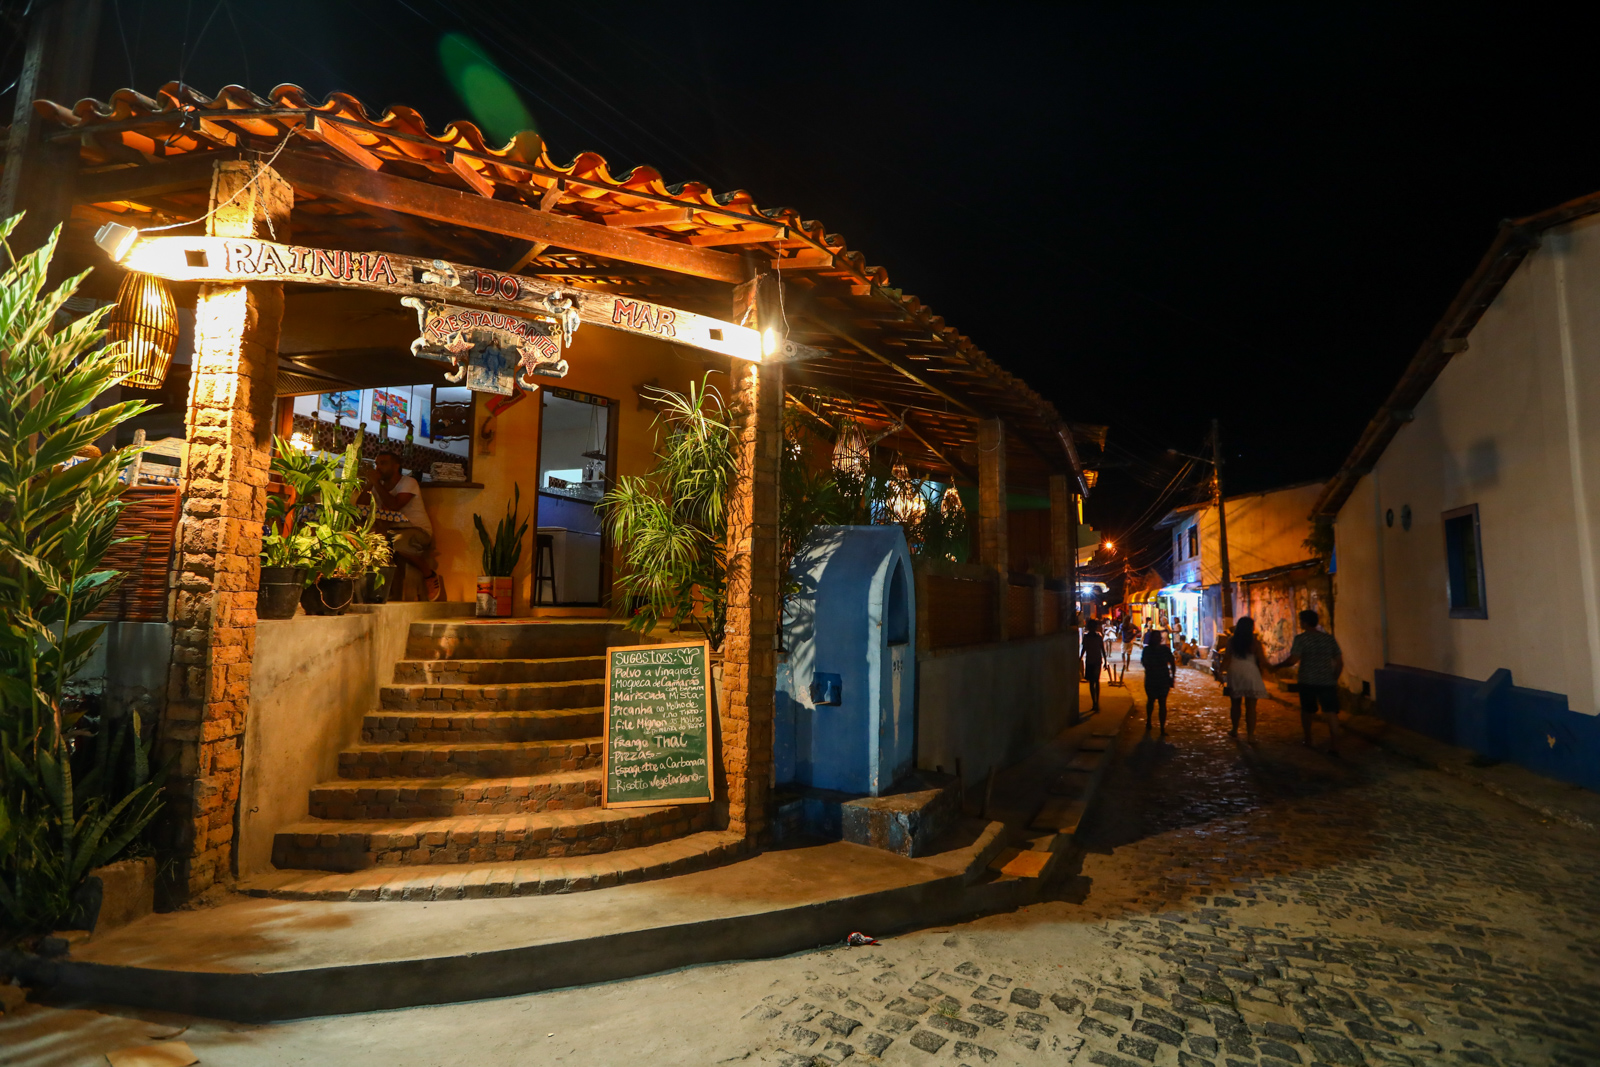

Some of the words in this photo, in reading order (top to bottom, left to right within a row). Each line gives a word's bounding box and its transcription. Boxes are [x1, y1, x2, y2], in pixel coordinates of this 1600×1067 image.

[224, 242, 398, 284] RAINHA
[474, 270, 520, 300] DO
[611, 299, 676, 336] MAR
[425, 311, 560, 358] RESTAURANTE
[614, 667, 642, 678] Polvo
[616, 680, 651, 693] Moqueca
[652, 679, 660, 688] de
[614, 690, 666, 702] Mariscada
[613, 702, 653, 716] Picanha
[614, 734, 649, 751] Frango
[654, 732, 687, 748] Thai
[616, 778, 648, 793] Risotto
